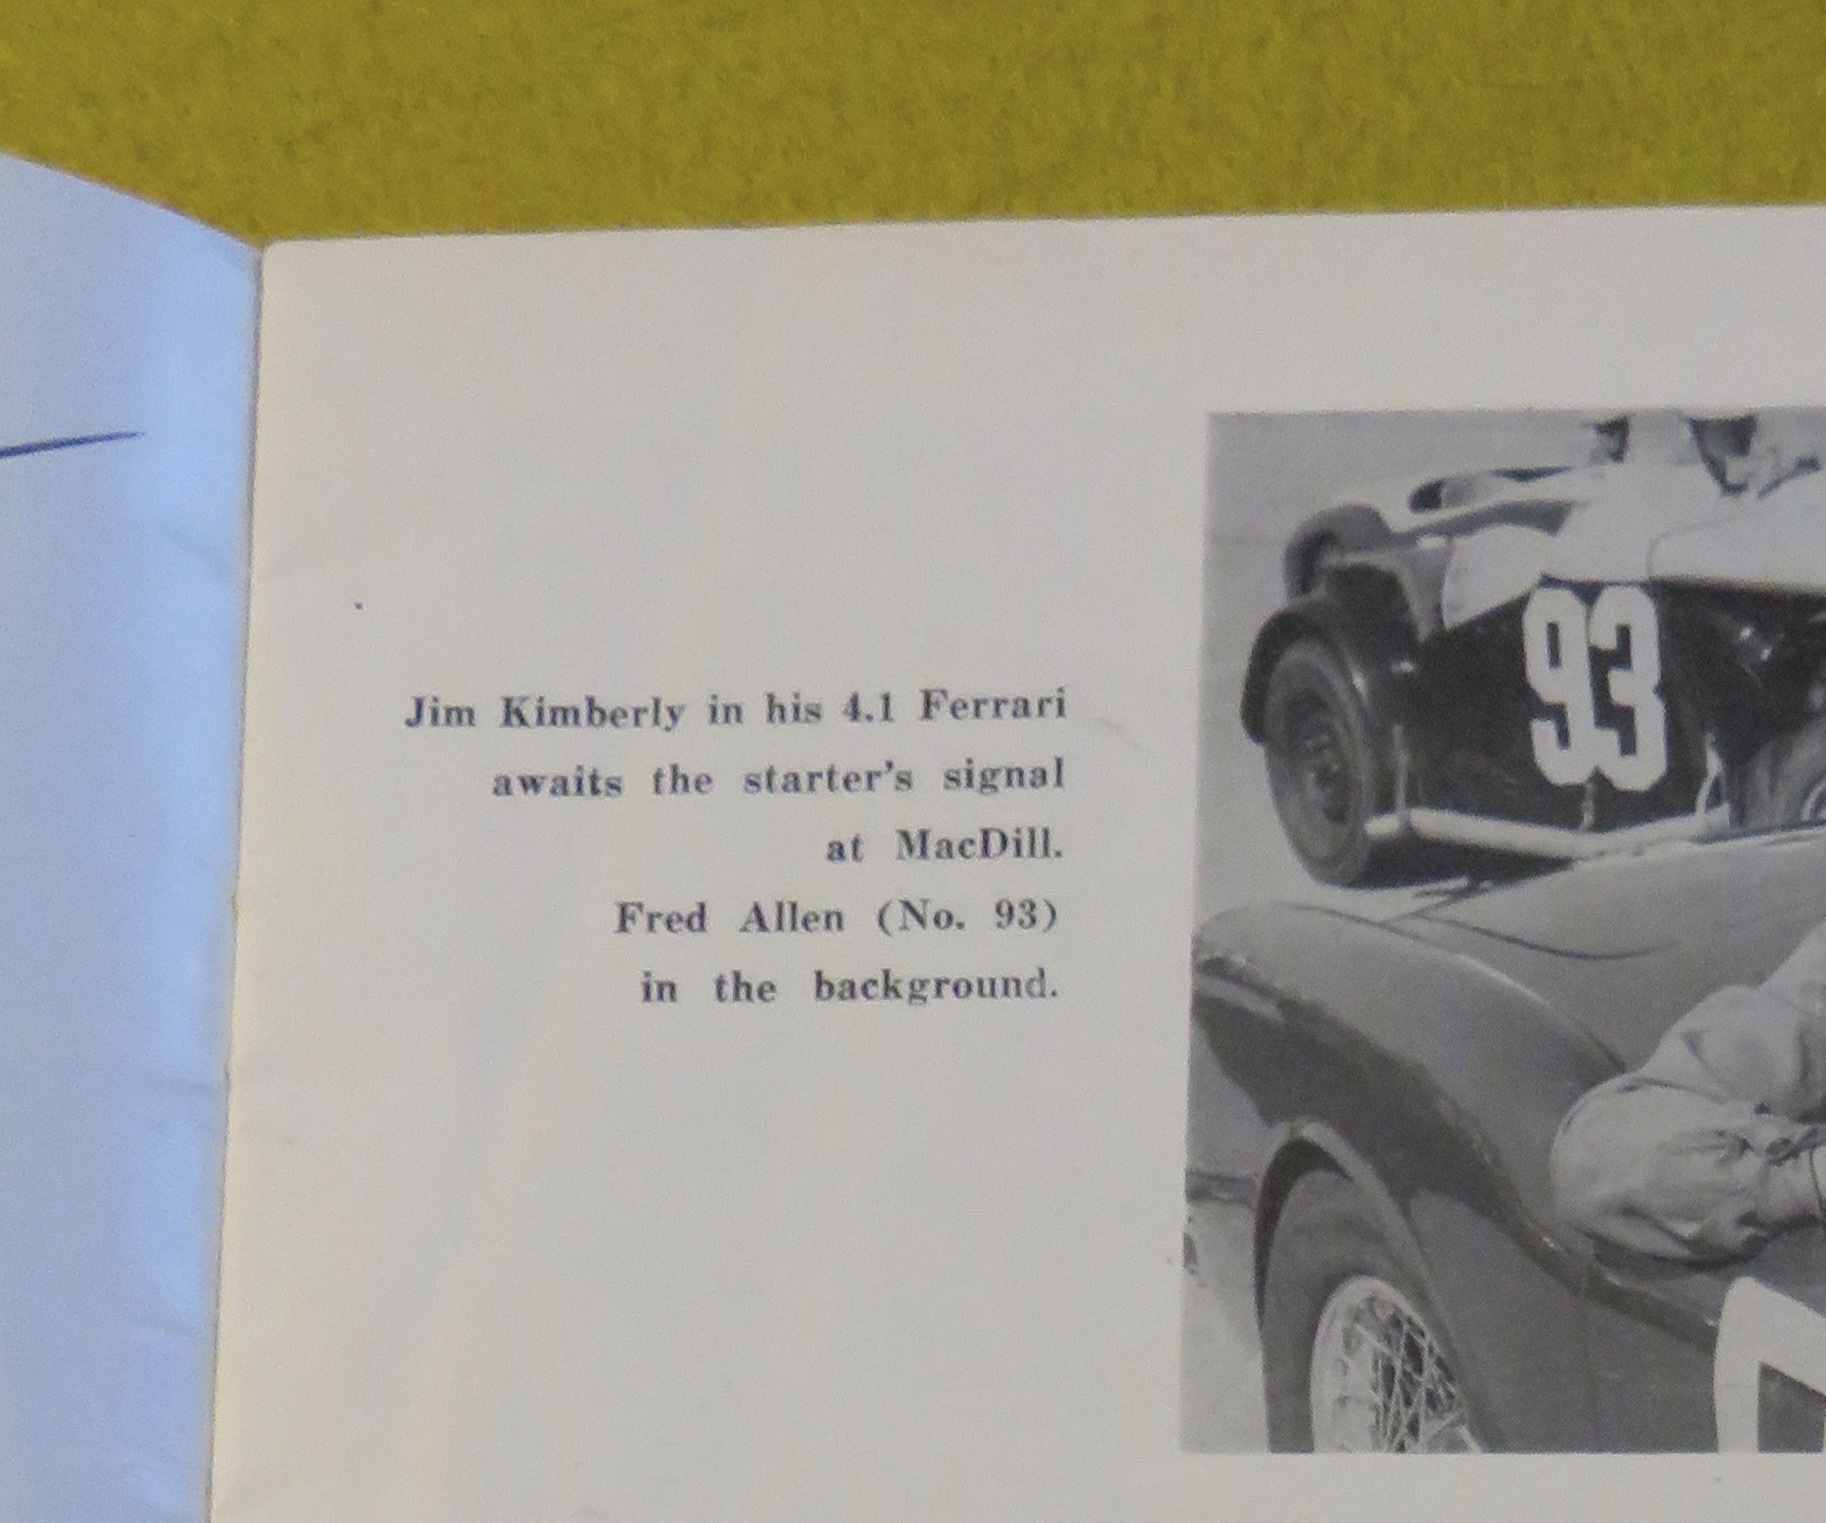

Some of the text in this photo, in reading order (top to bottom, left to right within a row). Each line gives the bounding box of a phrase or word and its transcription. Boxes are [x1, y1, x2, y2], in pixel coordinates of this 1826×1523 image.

[1522, 584, 1668, 792] 93
[404, 686, 1066, 732] Jim Kimberly in his 4.1 Ferrari
[492, 765, 622, 797] awaits
[652, 763, 713, 795] the
[944, 756, 1064, 795] signal
[825, 827, 1062, 862] at MacDill.
[617, 898, 1057, 936] Fred Allen (No. 93)
[641, 967, 1058, 1005] in the background.
